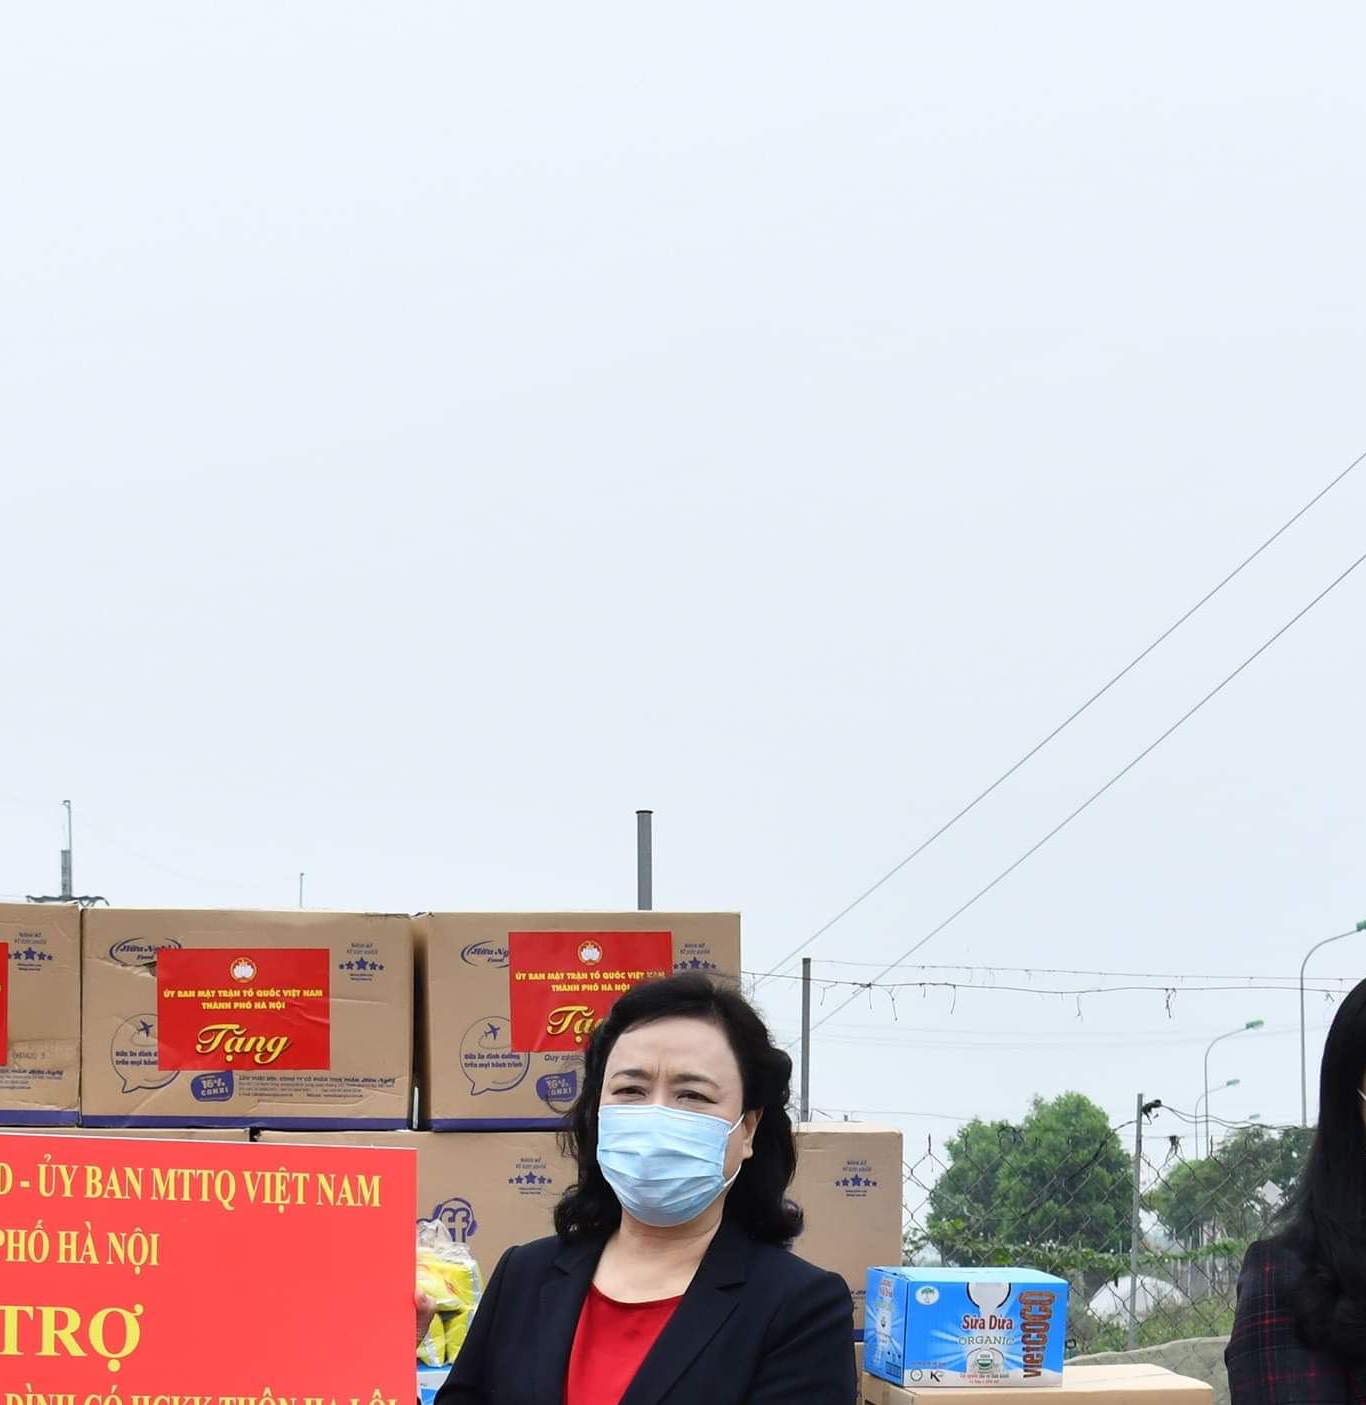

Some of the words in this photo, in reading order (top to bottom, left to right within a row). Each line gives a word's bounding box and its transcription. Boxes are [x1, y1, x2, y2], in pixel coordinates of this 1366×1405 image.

[195, 1023, 288, 1064] Tặng
[38, 1154, 78, 1197] ỦY
[84, 1166, 144, 1200] BAN
[151, 1168, 236, 1210] MTTQ
[243, 1166, 310, 1213] VIỆT
[316, 1174, 381, 1207] NAM
[57, 1221, 99, 1264] HÀ
[107, 1227, 159, 1275] NỘI
[958, 1335, 1015, 1346] ORGANIC
